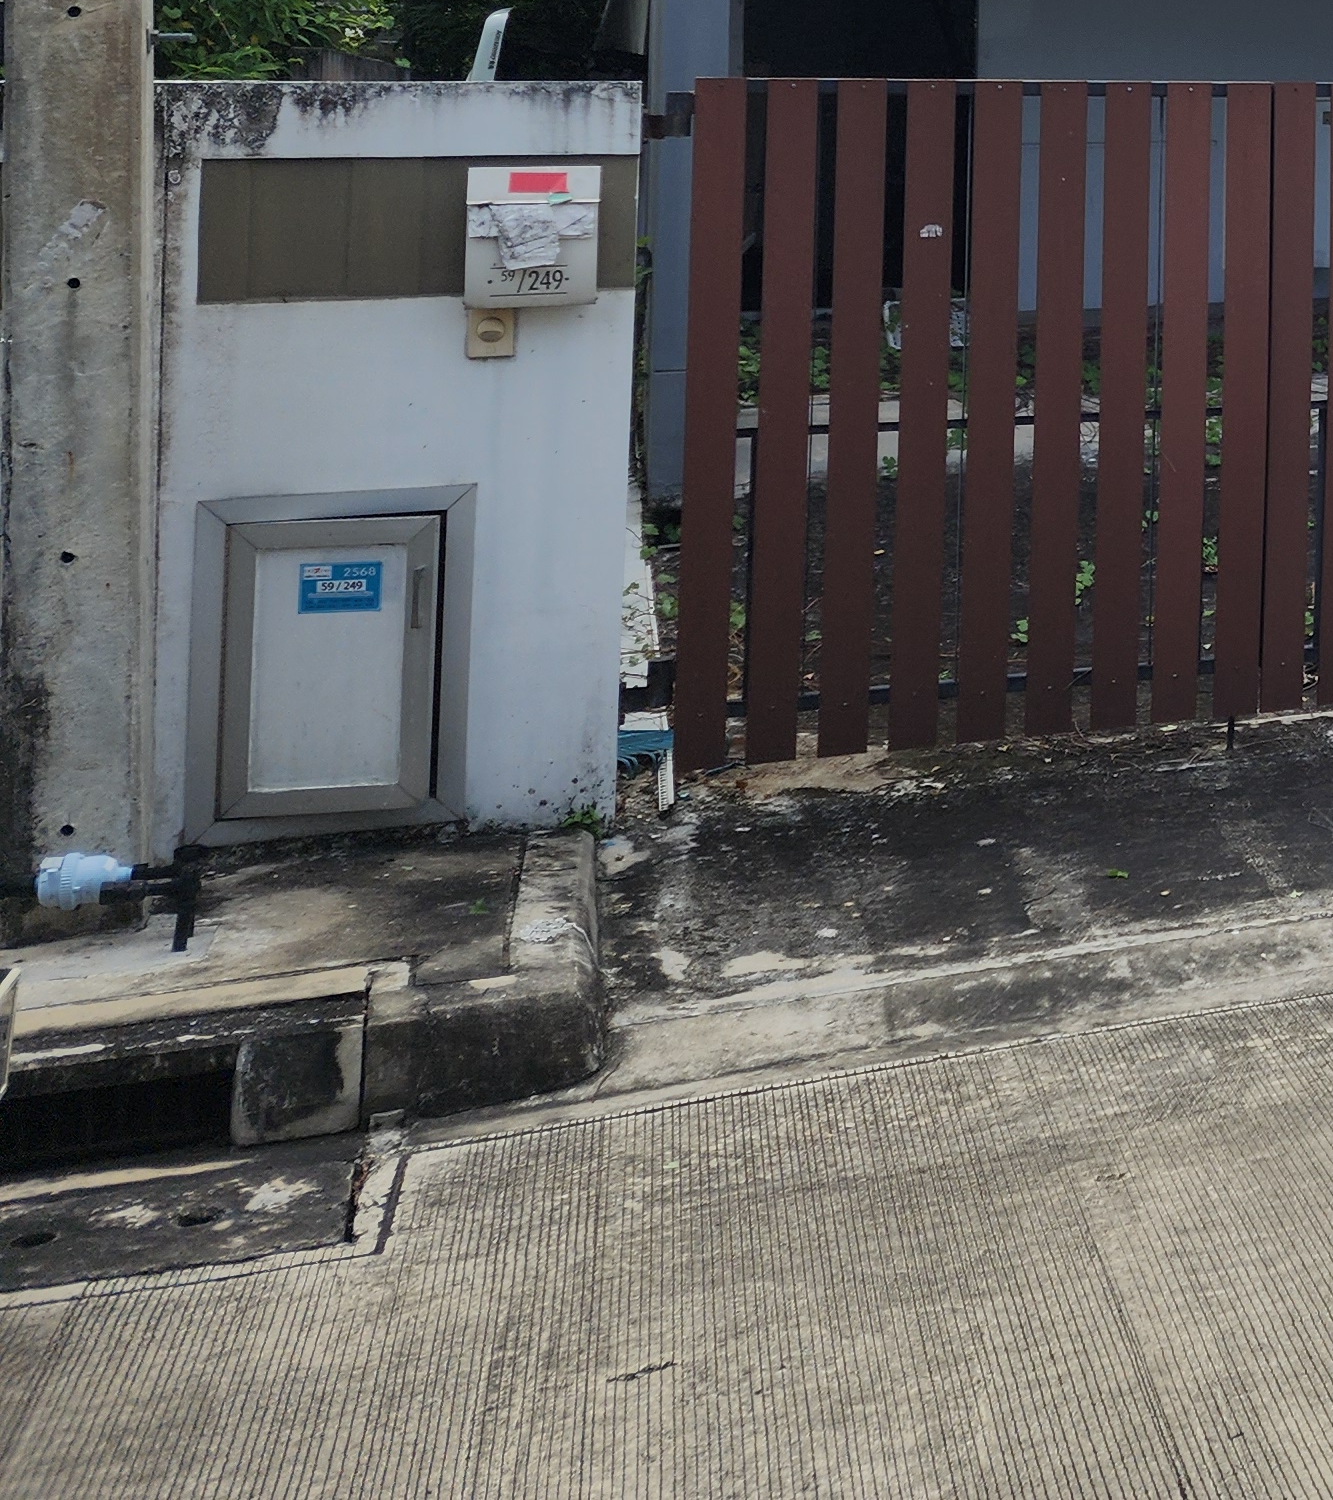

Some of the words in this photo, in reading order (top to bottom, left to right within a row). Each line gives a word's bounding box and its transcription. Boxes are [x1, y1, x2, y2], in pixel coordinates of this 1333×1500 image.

[344, 566, 376, 577] 2568
[321, 582, 334, 591] 59
[344, 581, 363, 590] 249
